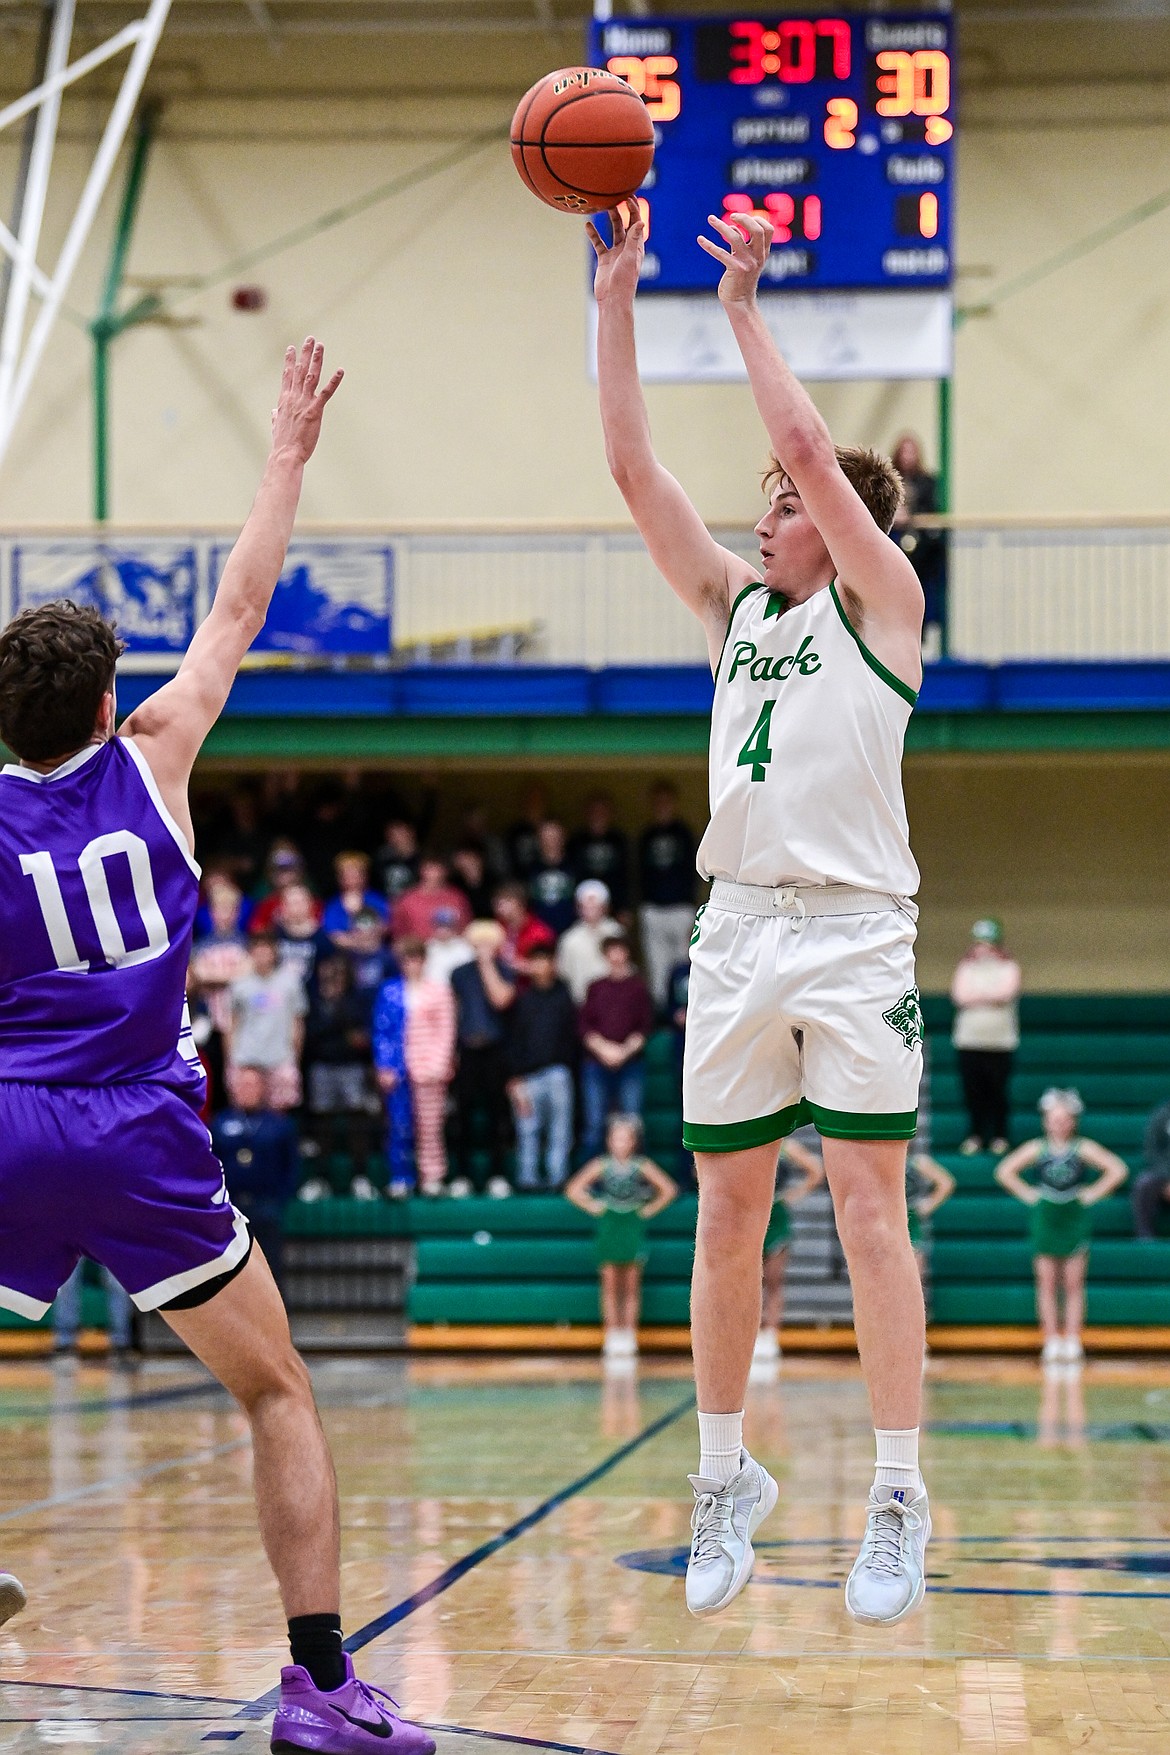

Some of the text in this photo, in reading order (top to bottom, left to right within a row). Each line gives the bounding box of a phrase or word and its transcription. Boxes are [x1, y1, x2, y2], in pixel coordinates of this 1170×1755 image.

[729, 19, 851, 84] 3:07
[875, 50, 950, 117] 30
[823, 97, 859, 149] 2
[919, 191, 938, 239] 1
[727, 635, 823, 684] Pack
[736, 699, 777, 782] 4
[18, 829, 171, 975] 10
